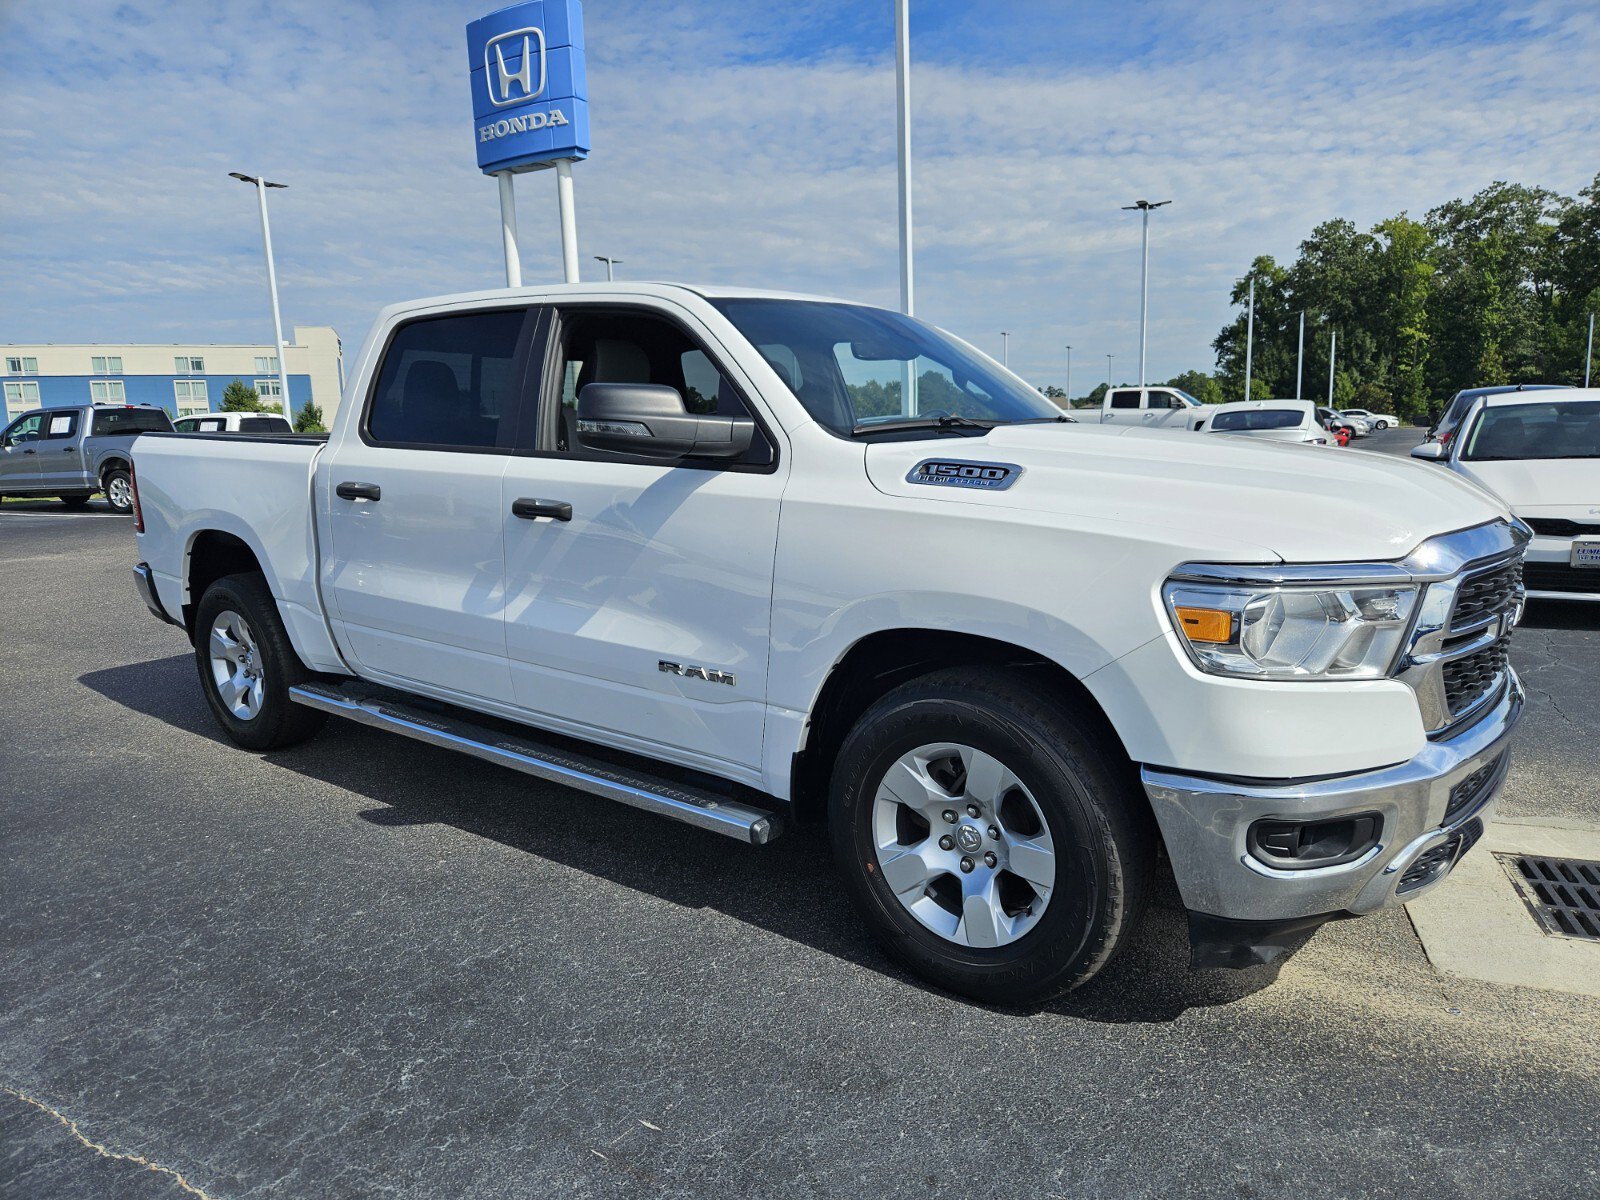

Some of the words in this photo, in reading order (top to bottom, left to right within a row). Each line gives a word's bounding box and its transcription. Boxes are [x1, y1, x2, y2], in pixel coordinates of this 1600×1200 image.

[478, 109, 569, 143] HONDA
[926, 464, 1006, 480] 1500
[658, 659, 736, 686] RAM
